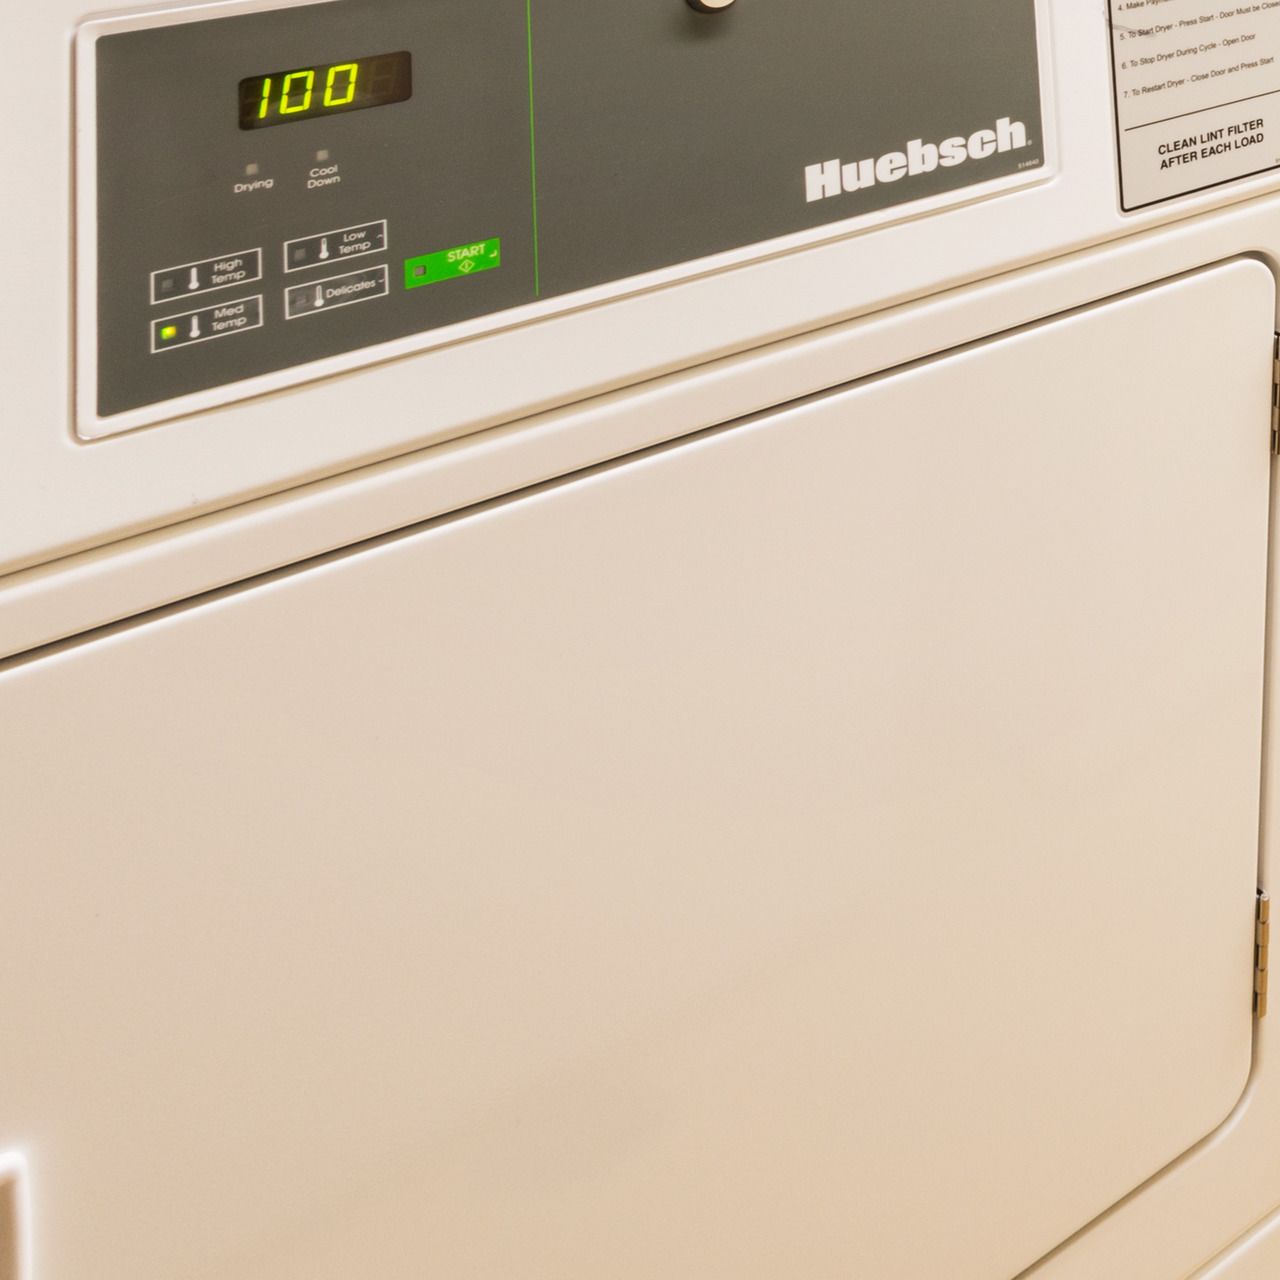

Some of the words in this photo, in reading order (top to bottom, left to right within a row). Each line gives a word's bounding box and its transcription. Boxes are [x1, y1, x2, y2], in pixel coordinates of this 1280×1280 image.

[1126, 0, 1144, 9] Make
[1137, 27, 1154, 36] Start
[1155, 24, 1173, 32] Dryer
[1179, 19, 1197, 27] Press
[1199, 14, 1214, 23] Start
[1220, 11, 1234, 19] Door
[1236, 6, 1251, 14] Must
[1140, 56, 1155, 65] Stop
[1157, 52, 1175, 62] Dryer
[1176, 47, 1198, 57] During
[1199, 43, 1217, 53] Cycle
[1222, 37, 1239, 47] Open
[1241, 34, 1256, 42] Door
[1132, 88, 1140, 96] To
[1141, 82, 1166, 94] Restart
[1167, 79, 1185, 88] Dryer
[1191, 73, 1209, 82] Close
[1210, 69, 1226, 77] Door
[1228, 65, 1239, 74] and
[1241, 61, 1258, 70] Press
[1259, 57, 1274, 65] Start
[258, 63, 358, 119] 100
[1158, 136, 1197, 155] CLEAN
[1200, 128, 1224, 144] LINT
[1227, 119, 1264, 136] FILTER
[1160, 151, 1198, 170] AFTER
[1201, 142, 1231, 158] EACH
[1235, 133, 1264, 149] LOAD
[805, 117, 1026, 203] Huebsch
[309, 164, 338, 177] Cool
[234, 178, 274, 193] Drying
[307, 175, 341, 189] Down
[343, 230, 366, 242] Low
[339, 241, 371, 255] Temp
[447, 243, 486, 262] START
[214, 258, 242, 273] High
[211, 269, 246, 285] Temp
[326, 278, 376, 298] Delicates
[214, 304, 244, 320] Med
[212, 316, 247, 332] Temp
